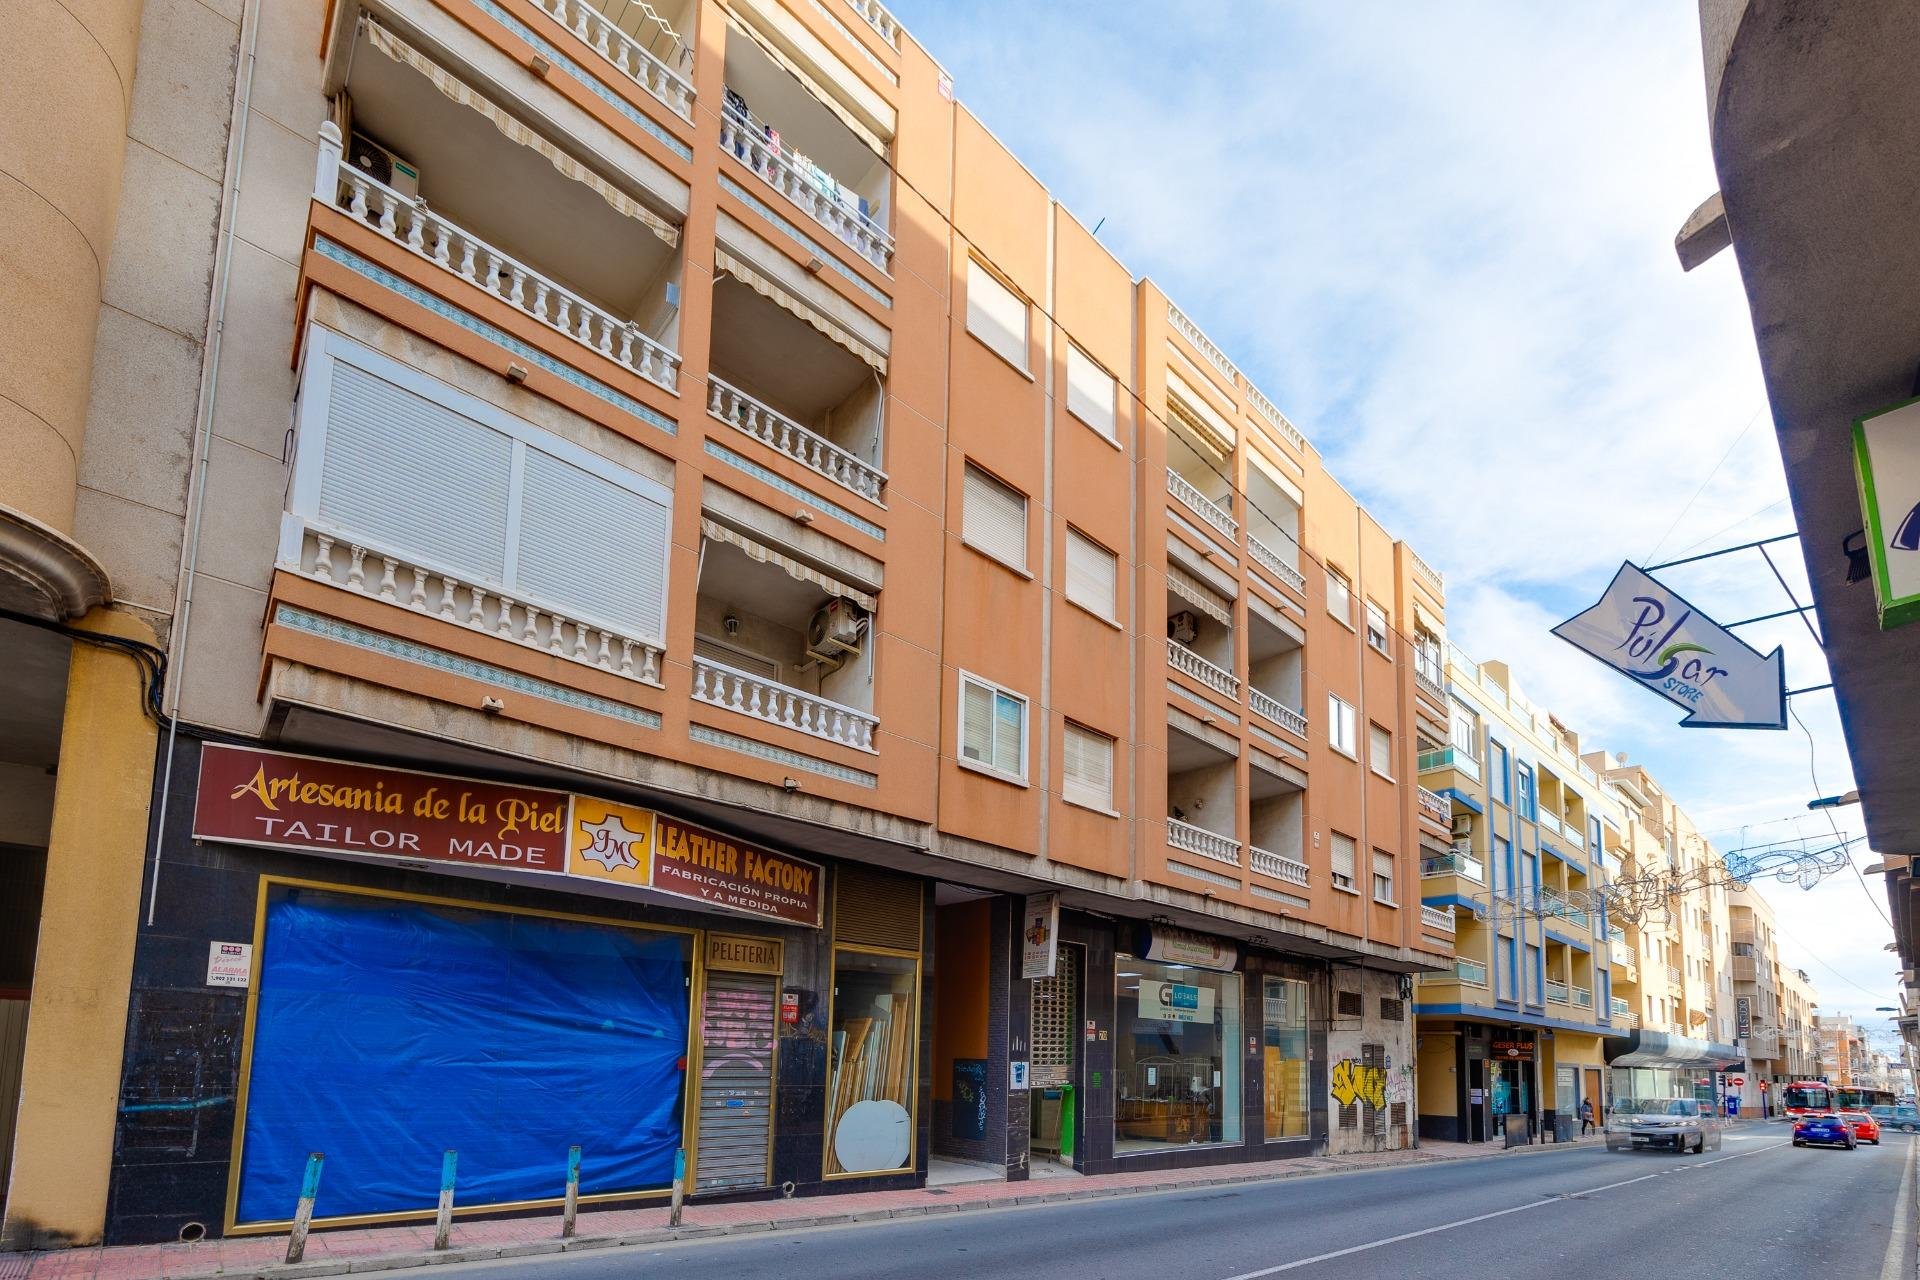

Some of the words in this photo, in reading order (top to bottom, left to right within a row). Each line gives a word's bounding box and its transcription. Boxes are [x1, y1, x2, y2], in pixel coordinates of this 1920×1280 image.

[1663, 677, 1704, 703] STORE
[230, 761, 404, 815] Artesania
[413, 787, 450, 820] de
[459, 792, 487, 825] la
[496, 798, 565, 840] Piel
[255, 816, 422, 851] TAILOR
[449, 838, 546, 865] MADE
[656, 823, 738, 877] LEATHER
[744, 850, 814, 896] FACTORY
[661, 865, 760, 898] FABRICACIÓN
[764, 892, 808, 909] PROPIA
[700, 888, 710, 897] Y
[714, 891, 723, 900] A
[728, 894, 778, 914] MEDIDA
